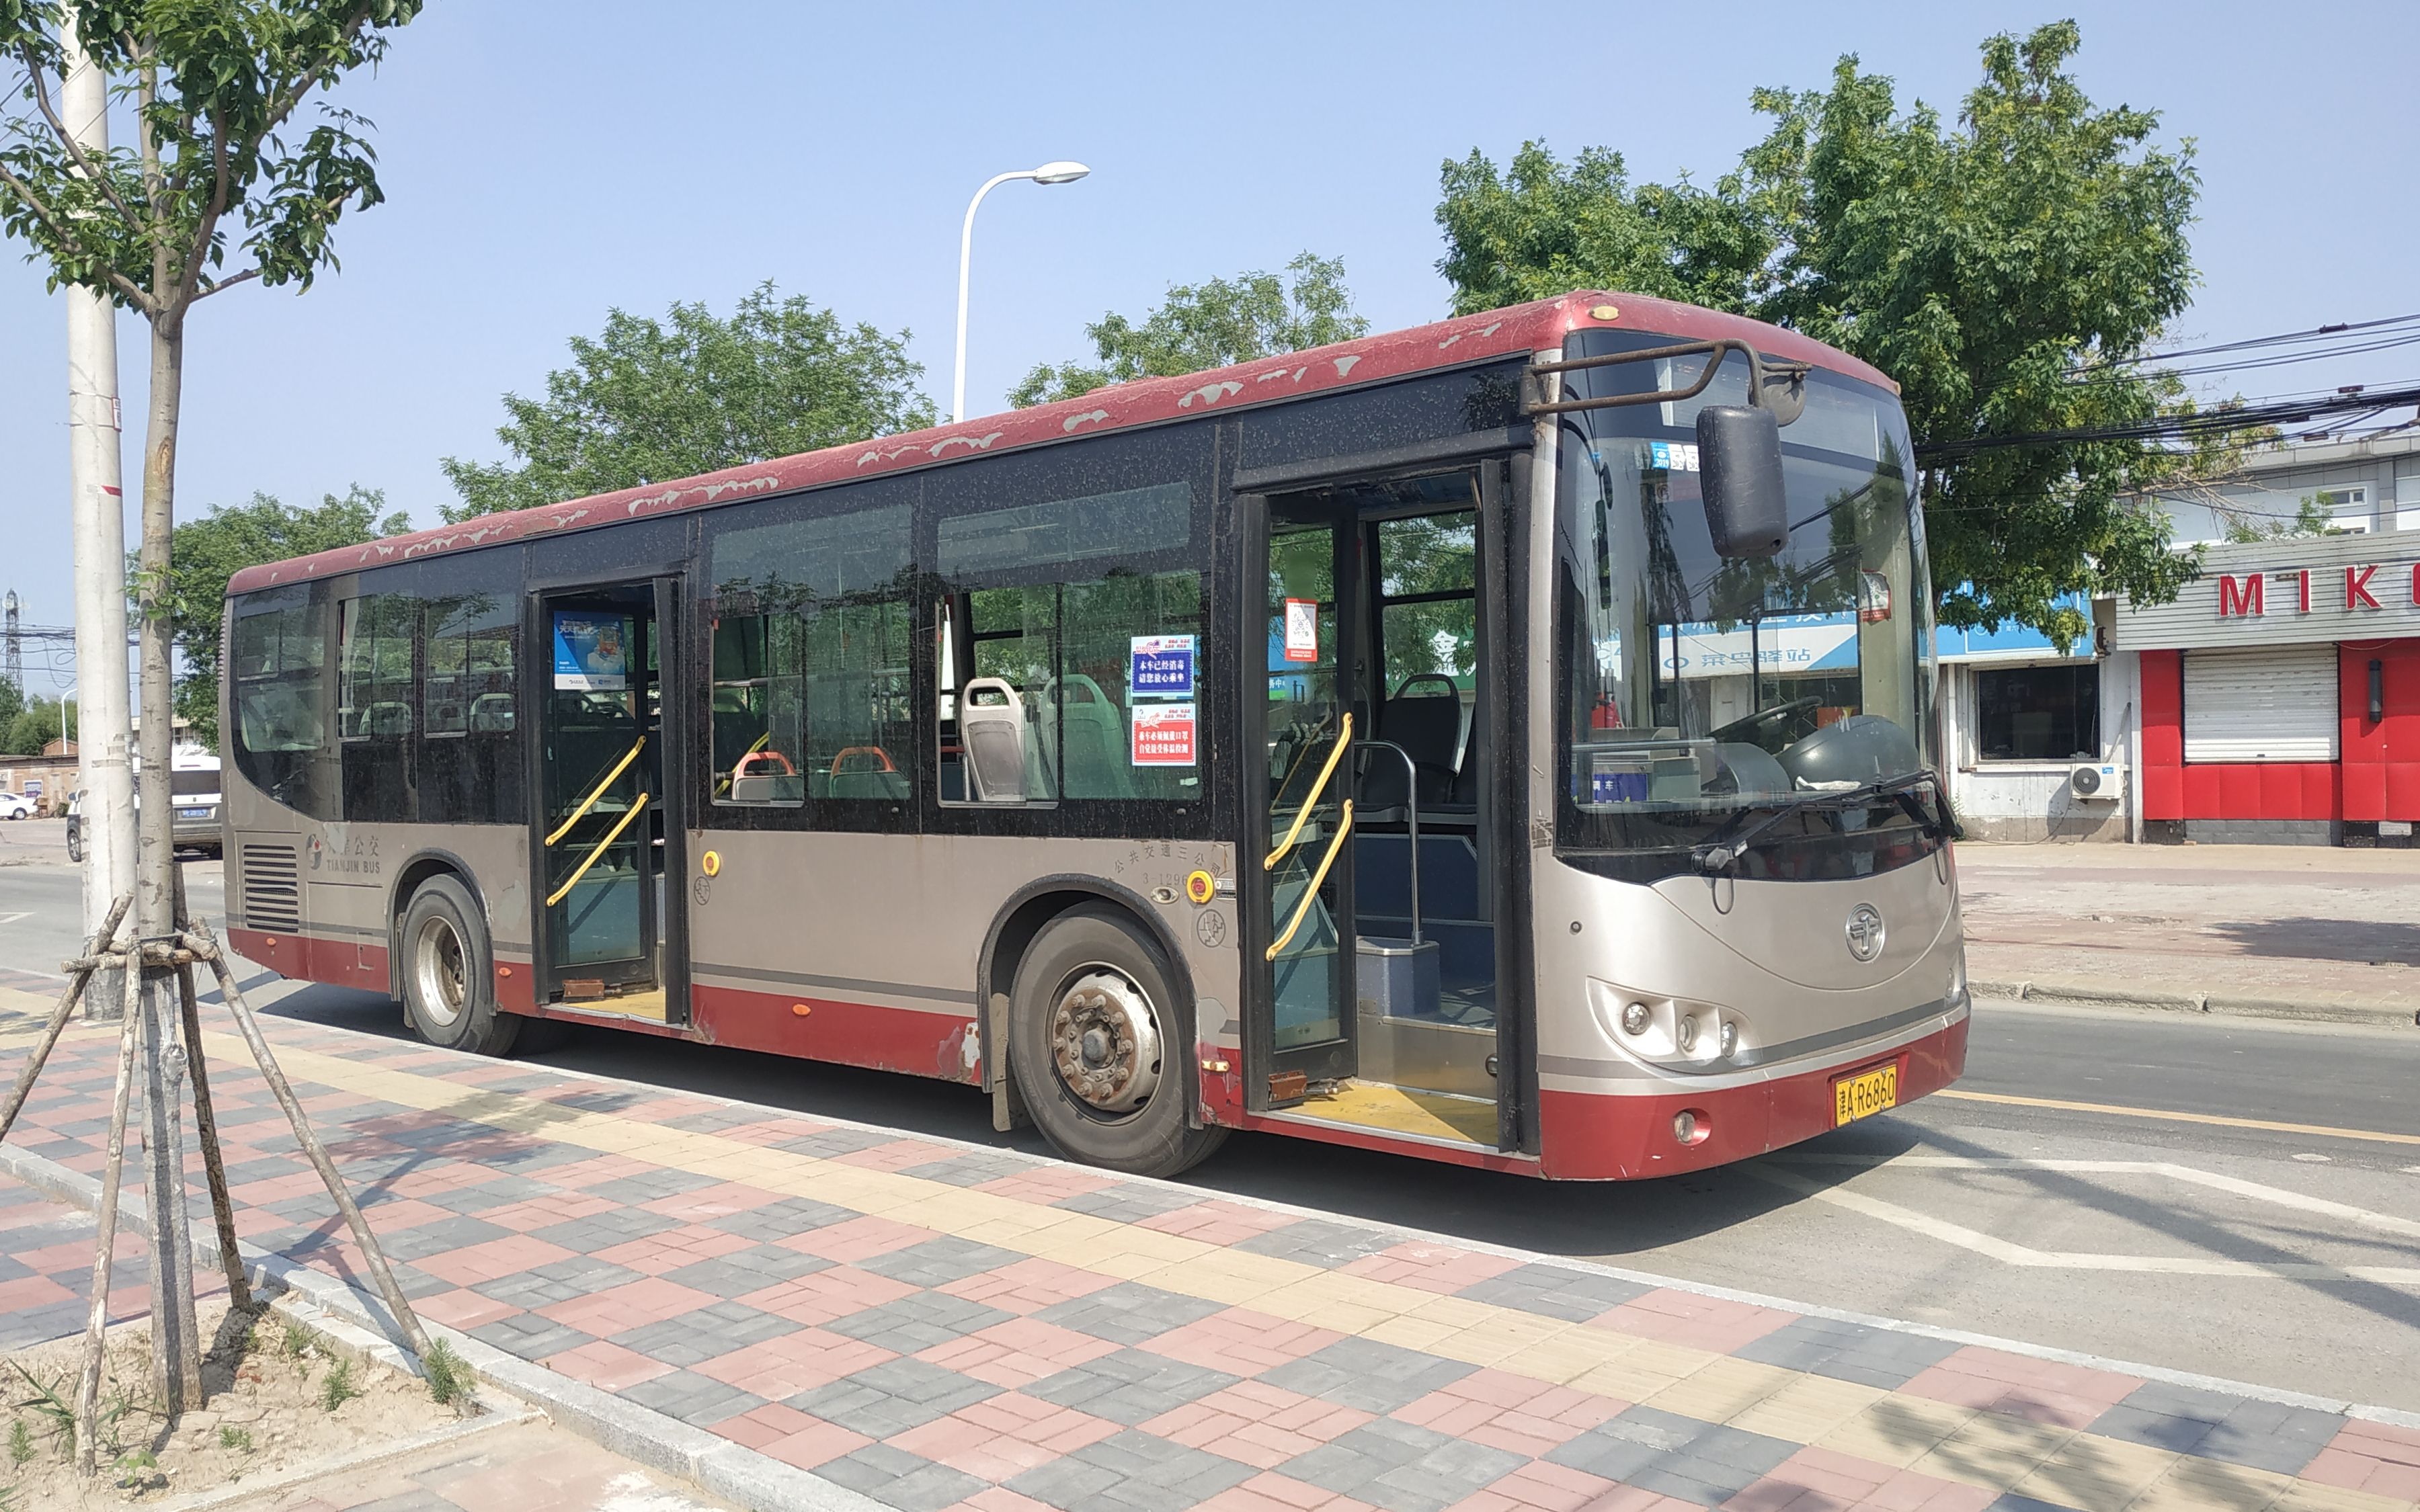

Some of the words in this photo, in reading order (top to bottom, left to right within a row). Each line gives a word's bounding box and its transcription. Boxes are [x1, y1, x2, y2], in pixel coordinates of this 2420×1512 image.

[2219, 562, 2420, 618] MIK
[1139, 659, 1184, 671] 本车已经消毒
[1701, 648, 1811, 667] 菜鸟驿站
[1139, 673, 1184, 683] 请您放心乘坐
[327, 859, 359, 872] TIANJIN
[363, 861, 380, 874] BUS
[1114, 844, 1221, 878] 公共交通三公司
